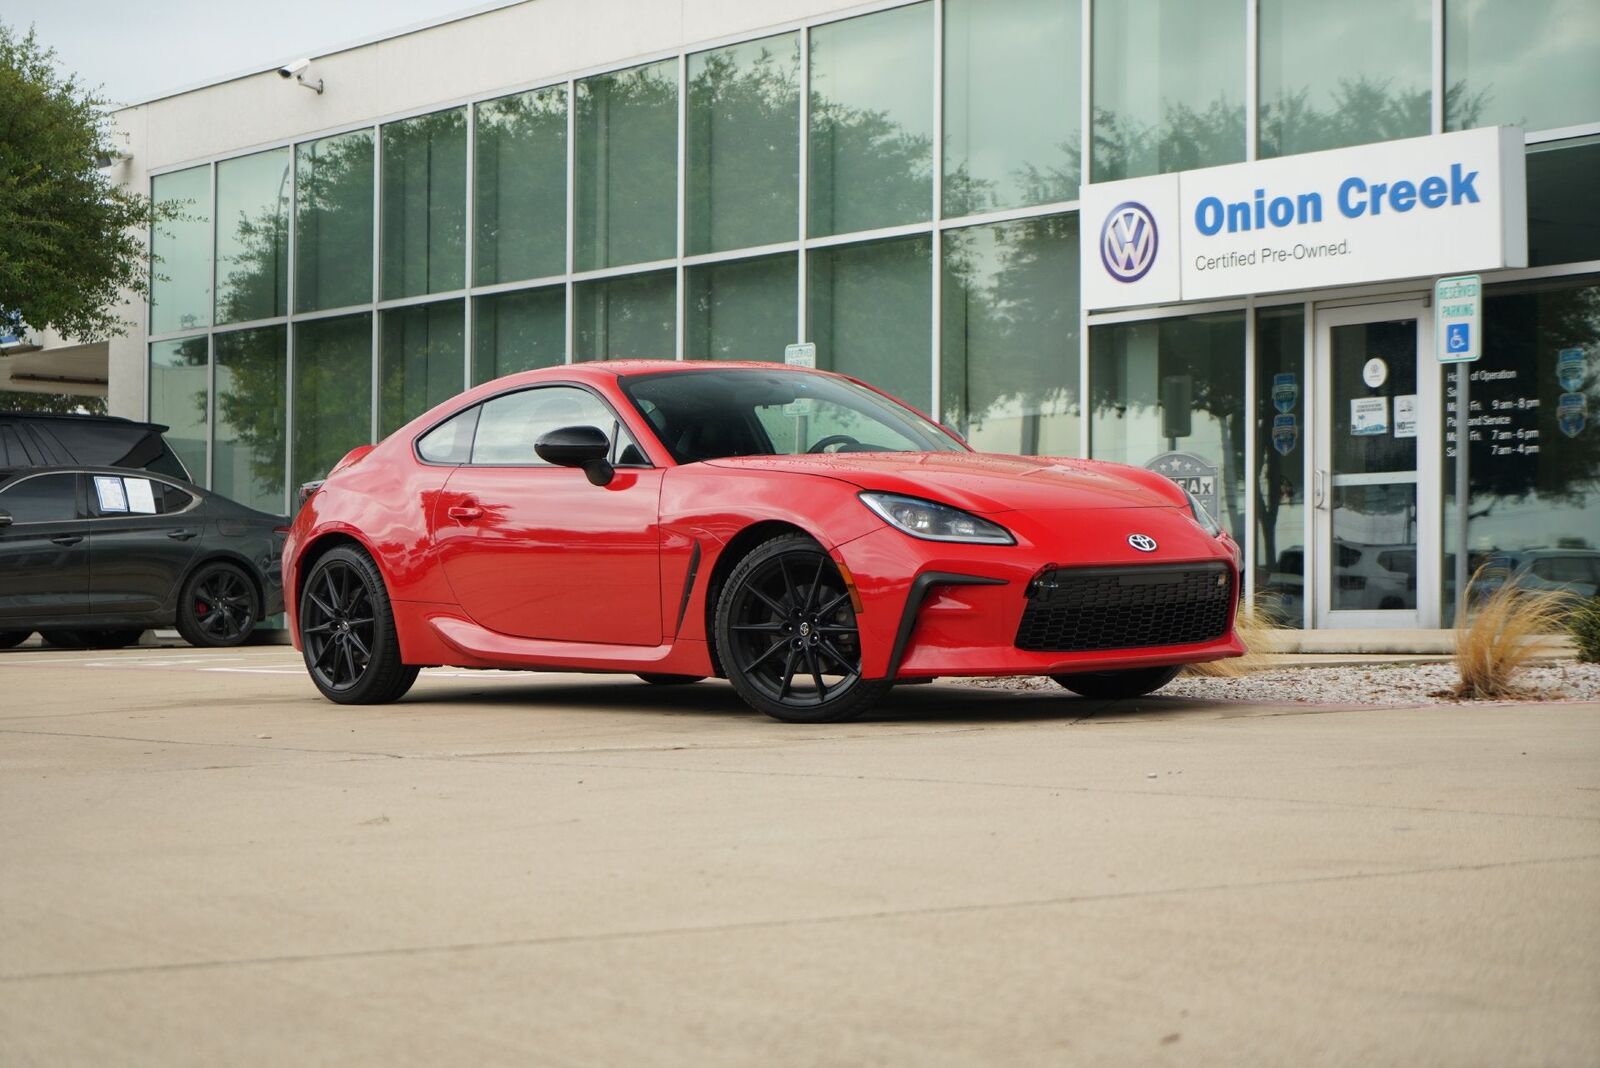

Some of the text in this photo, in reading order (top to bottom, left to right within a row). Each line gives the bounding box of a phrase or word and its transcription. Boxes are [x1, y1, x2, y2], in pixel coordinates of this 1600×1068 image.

[1195, 163, 1481, 237] Onion Creek
[1195, 238, 1352, 271] Certified Pre-Owned.
[1439, 284, 1477, 299] RESERVED
[1442, 303, 1473, 317] PARKING
[1470, 370, 1517, 381] of Operation
[1467, 417, 1482, 426] and
[1483, 416, 1511, 425] Service
